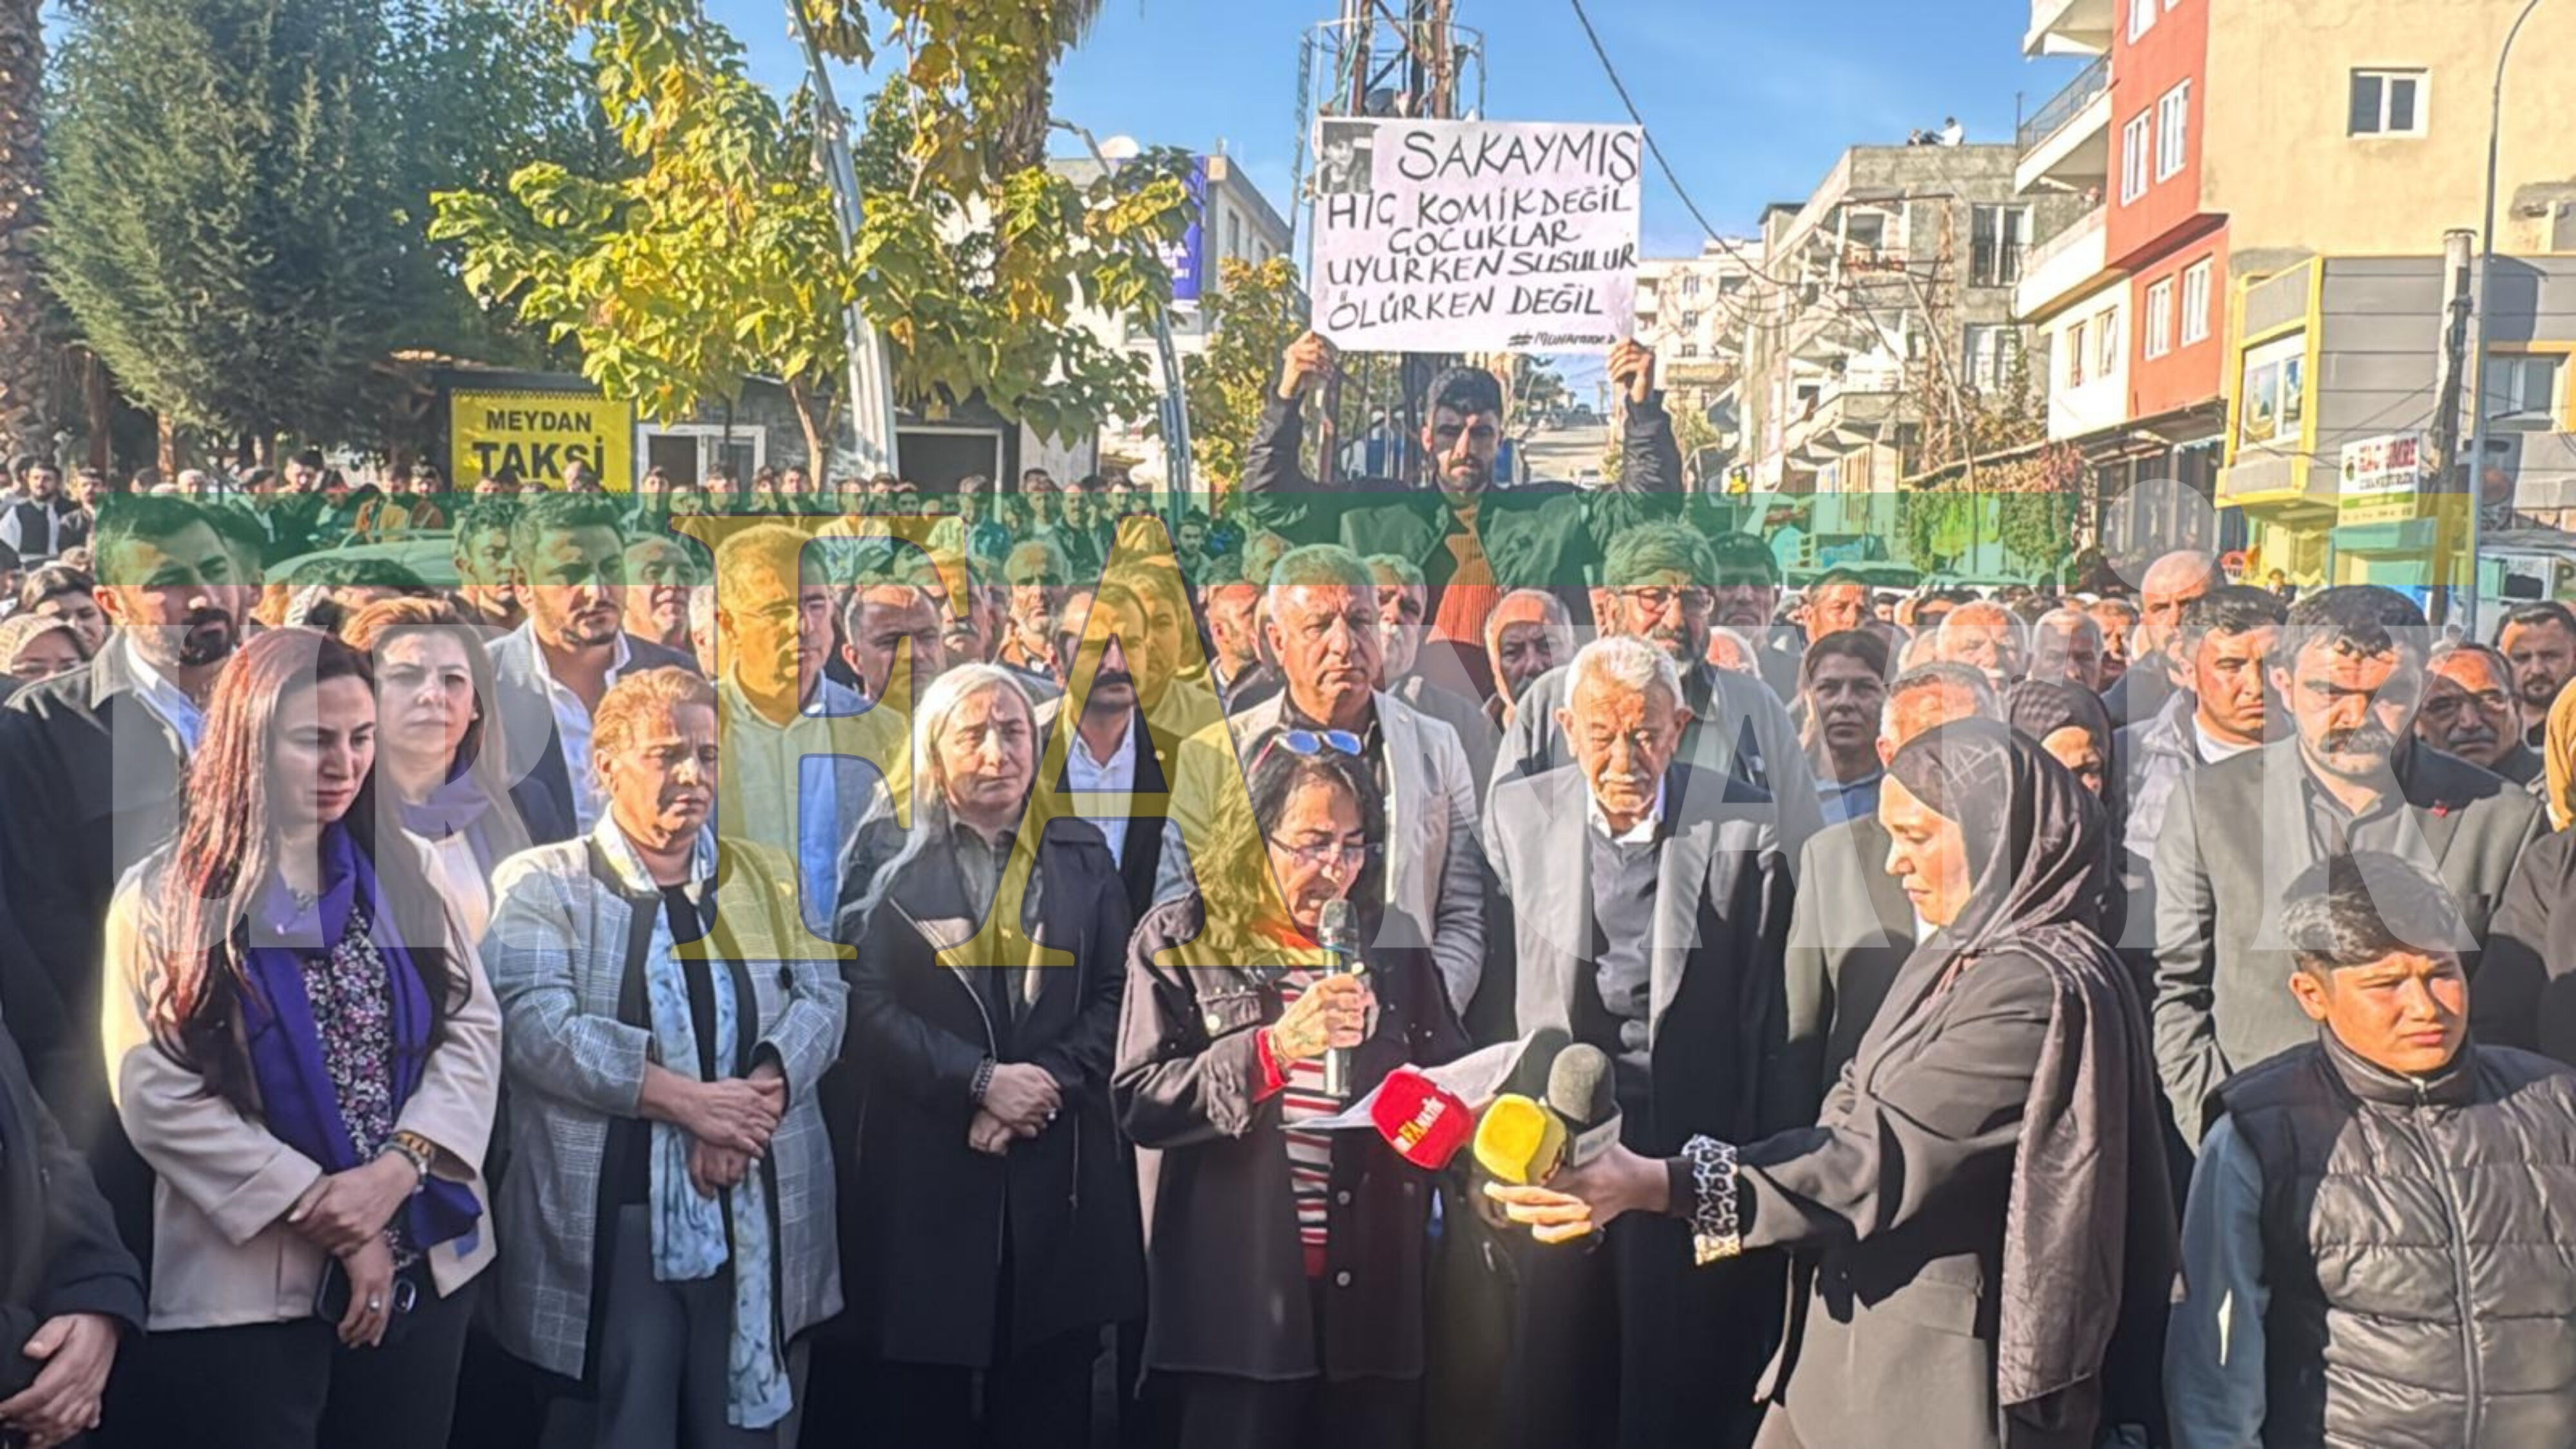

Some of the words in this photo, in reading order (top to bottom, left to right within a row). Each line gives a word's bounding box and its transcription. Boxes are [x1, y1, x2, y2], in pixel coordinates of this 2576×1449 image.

[1418, 187, 1537, 229] KOMİK
[1540, 184, 1633, 216] DEĞİL
[1388, 220, 1582, 256] ÇOCUKLAR
[1328, 249, 1504, 286] UYURKEN
[1508, 243, 1638, 275] SUSULUR
[1328, 286, 1495, 331] ÖLÜRKEN
[1507, 283, 1603, 315] DEĞİL
[486, 410, 591, 432] MEYDAN
[472, 435, 604, 480] TAKSİ
